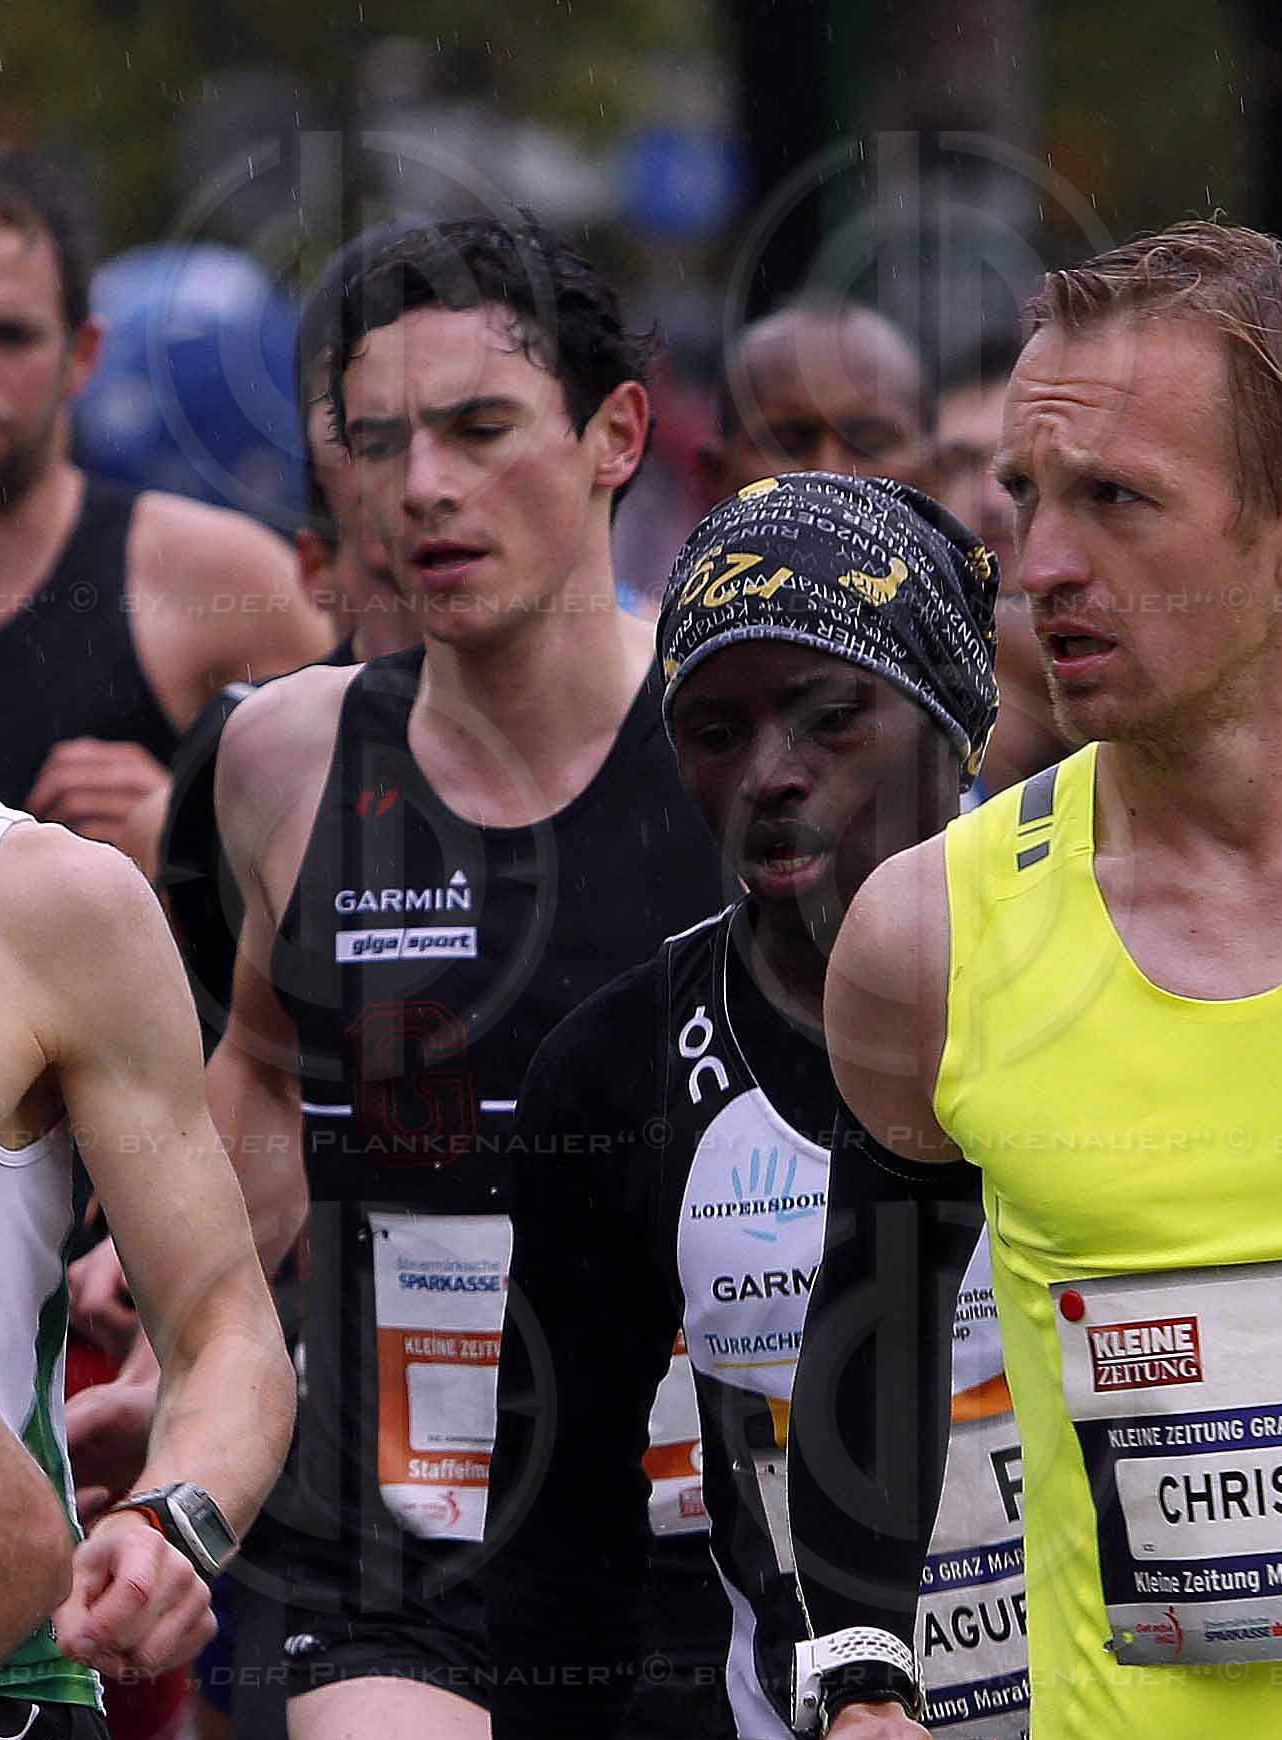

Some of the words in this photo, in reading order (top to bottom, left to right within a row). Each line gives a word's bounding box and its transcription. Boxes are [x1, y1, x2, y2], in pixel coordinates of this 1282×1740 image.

[334, 888, 471, 913] GARMIN
[407, 931, 471, 952] sport
[397, 1273, 501, 1292] SPARKASSE
[1093, 1322, 1193, 1358] KLEINE
[1097, 1358, 1199, 1386] ZEITUNG
[1107, 1427, 1161, 1449] KLEINE
[1165, 1421, 1244, 1446] ZEITUNG
[939, 1559, 984, 1581] GRAZ
[1133, 1570, 1180, 1593] Kleine
[1183, 1564, 1261, 1596] Zeitung
